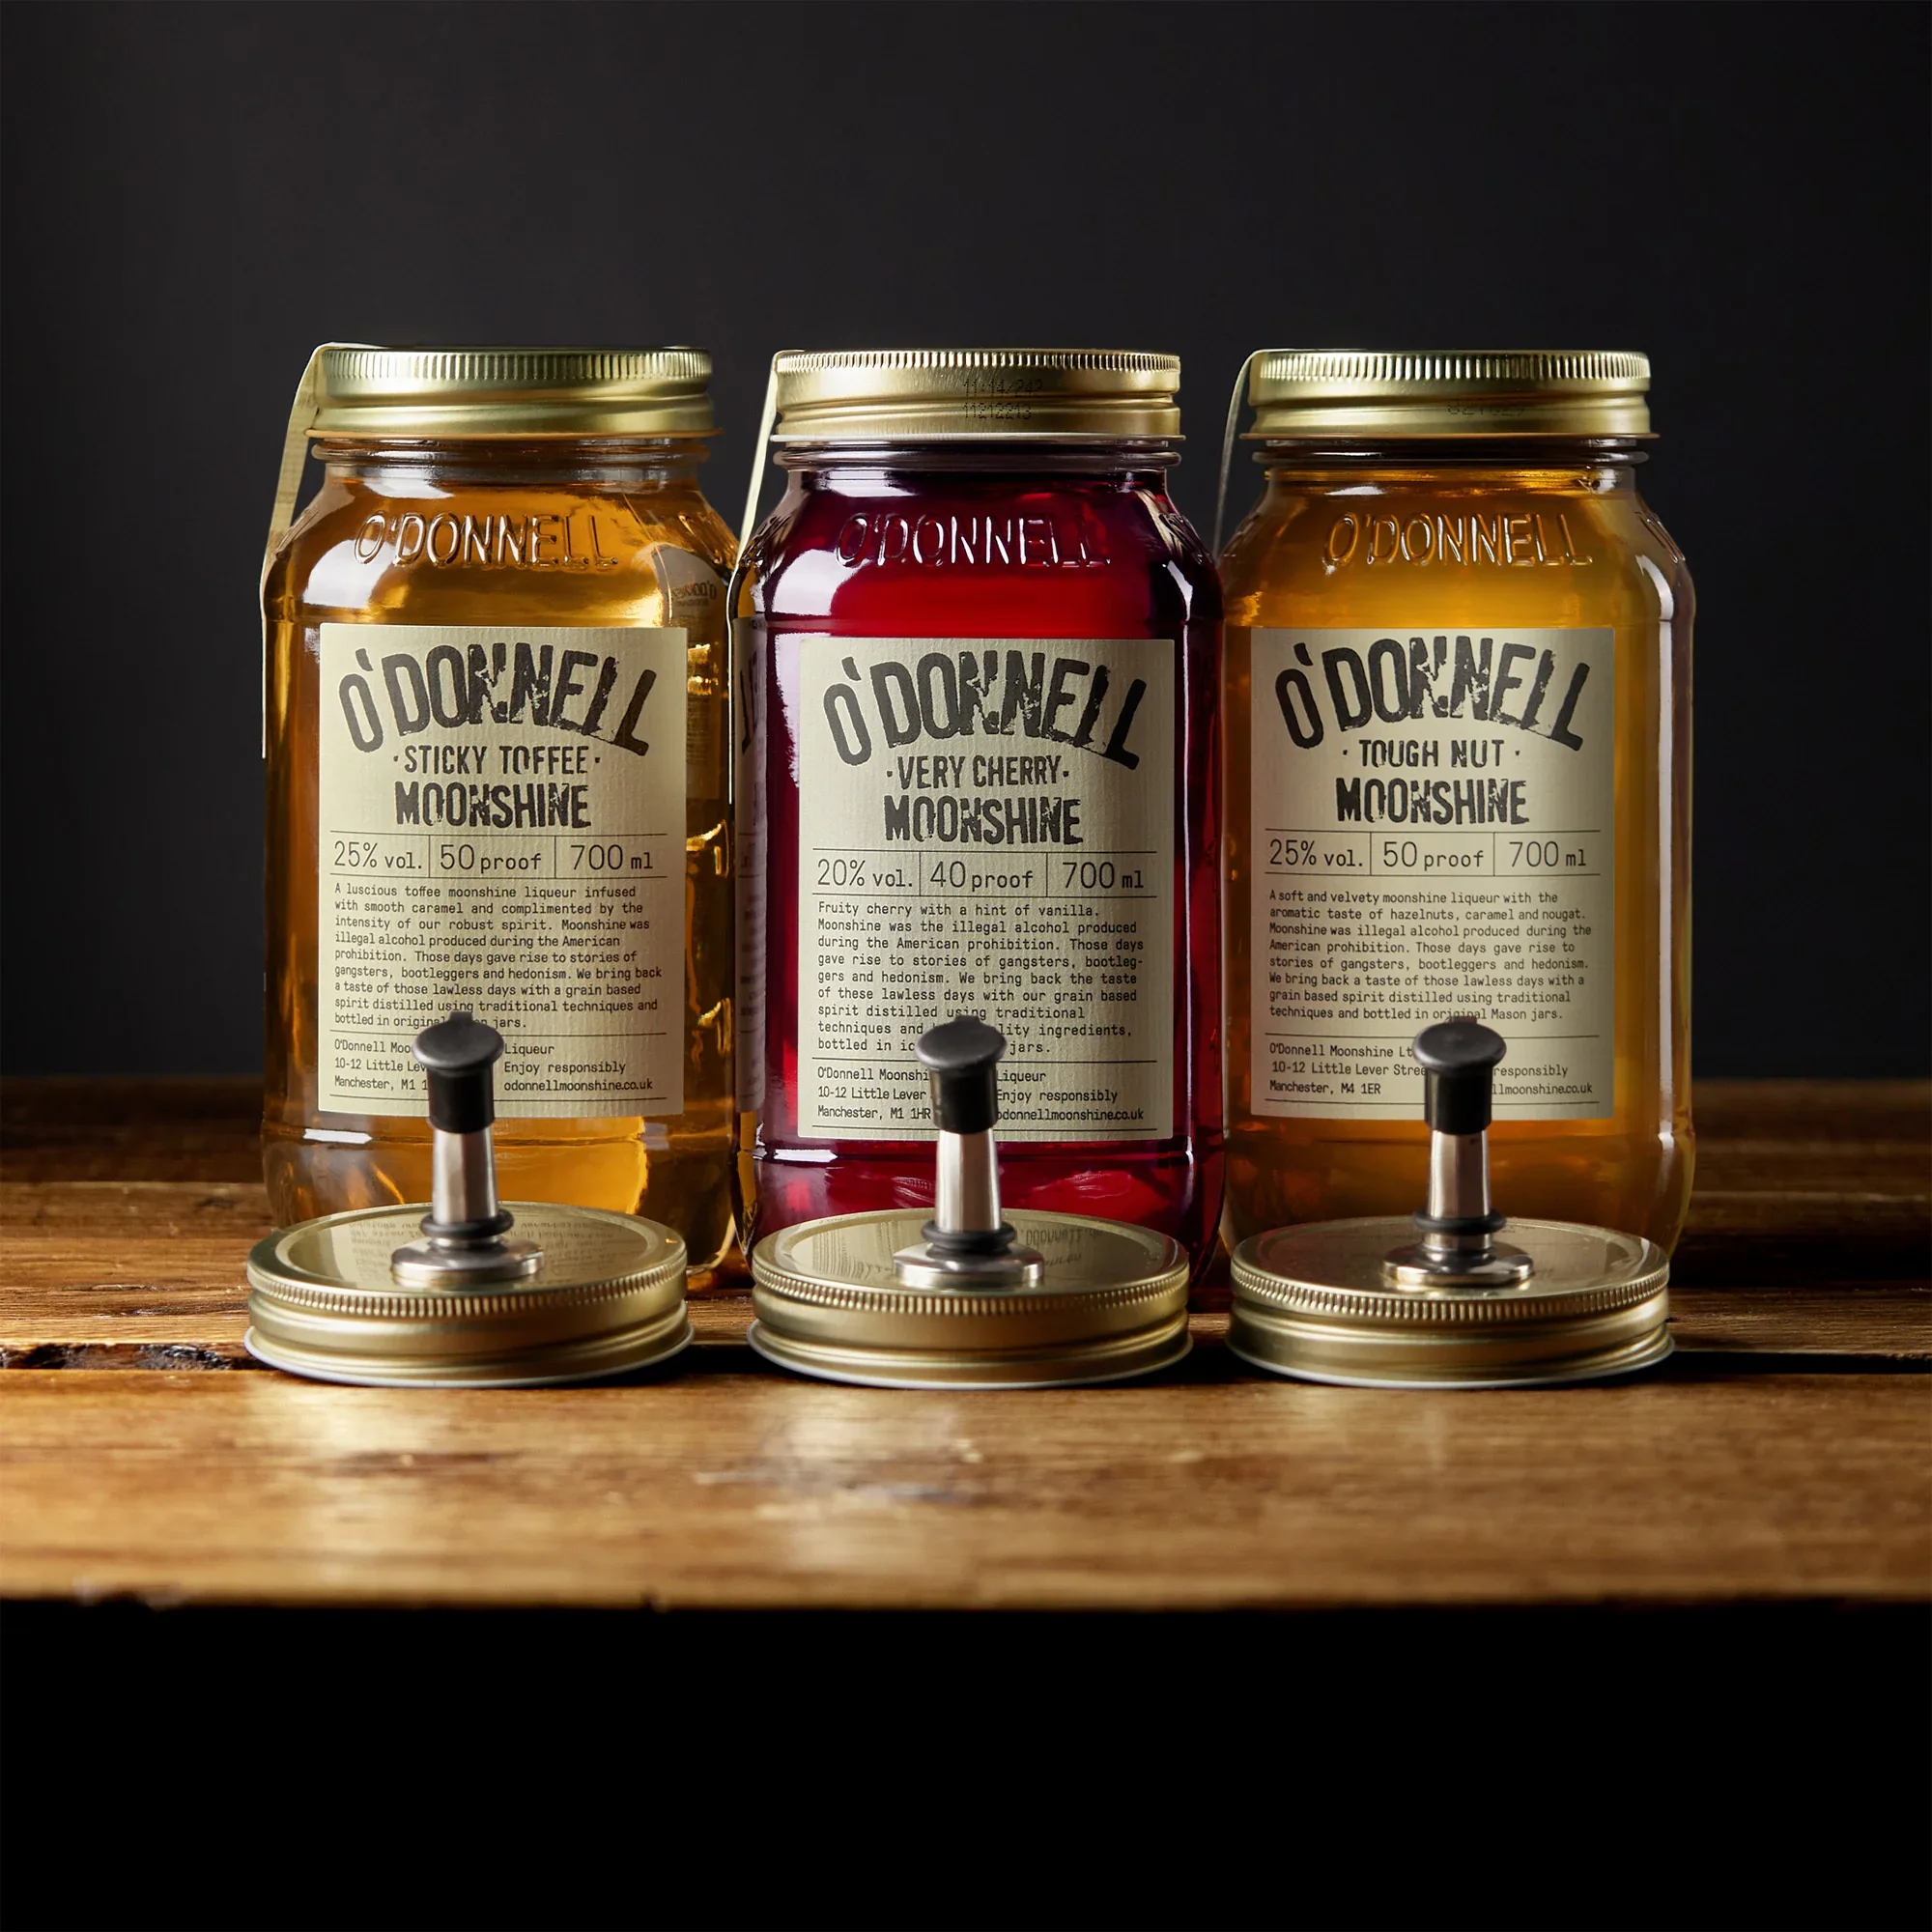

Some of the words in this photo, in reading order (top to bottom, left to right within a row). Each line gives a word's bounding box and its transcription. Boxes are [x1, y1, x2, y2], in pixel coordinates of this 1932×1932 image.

[355, 512, 618, 567] O'DONNELL
[837, 512, 1111, 567] O'DONNELL
[1324, 512, 1593, 567] O'DONNELL
[339, 642, 656, 756] O'DONNELL
[1275, 635, 1590, 752] O'DONNELL
[823, 650, 1147, 770] O'DONNELL
[405, 745, 487, 775] STICKY
[499, 745, 589, 775] TOFFEE
[1358, 739, 1438, 768] TOUGH
[1451, 739, 1505, 768] NUT
[897, 755, 965, 790] VERY
[973, 755, 1062, 787] CHERRY
[395, 781, 591, 828] MOONSHINE
[1336, 777, 1530, 825] MOONSHINE
[884, 795, 1084, 845] MOONSHINE
[333, 840, 378, 868] 25%
[384, 852, 421, 868] vol.
[440, 844, 474, 869] 50
[481, 853, 541, 874] proof
[570, 844, 624, 871] 700
[630, 852, 653, 869] ml
[1270, 838, 1317, 866] 25%
[1324, 849, 1362, 867] vol.
[1383, 841, 1417, 867] 50
[1425, 850, 1484, 871] proof
[1509, 841, 1558, 867] 700
[1566, 849, 1586, 866] ml
[818, 859, 866, 886] 20%
[872, 869, 912, 887] vol.
[930, 861, 966, 888] 40
[972, 870, 1034, 893] proof
[1063, 862, 1115, 889] 700
[1122, 870, 1145, 890] ml
[335, 883, 340, 893] A
[348, 883, 397, 895] luscious
[405, 886, 440, 896] toffee
[448, 887, 516, 897] moonshine
[525, 886, 577, 899] liqueur
[585, 886, 636, 897] infused
[1269, 890, 1276, 899] A
[1279, 890, 1303, 901] soft
[1307, 891, 1326, 901] and
[1330, 892, 1379, 905] velvety
[1383, 893, 1446, 903] moonshine
[1451, 893, 1499, 905] liqueur
[1503, 893, 1531, 903] with
[1539, 893, 1557, 902] the
[335, 900, 357, 910] with
[365, 902, 404, 912] smooth
[412, 902, 463, 914] caramel
[471, 903, 493, 914] and
[502, 902, 591, 916] complimented
[600, 903, 613, 916] by
[622, 902, 643, 913] the
[819, 901, 859, 916] Fruity
[867, 903, 912, 917] cherry
[921, 903, 951, 915] with
[960, 907, 966, 916] a
[976, 904, 1007, 916] hint
[1015, 904, 1030, 916] of
[1038, 904, 1098, 916] vanilla.
[1270, 907, 1320, 919] aromatic
[1327, 908, 1361, 920] taste
[1370, 908, 1382, 920] of
[1391, 909, 1459, 921] hazelnuts,
[1465, 909, 1514, 920] caramel
[1519, 909, 1538, 920] and
[1543, 908, 1584, 922] nougat.
[336, 917, 390, 930] intensity
[398, 918, 411, 928] of
[449, 919, 494, 930] robust
[502, 919, 552, 932] spirit.
[562, 919, 626, 930] Moonshine
[630, 921, 649, 929] was
[818, 919, 881, 931] Moonshine
[889, 923, 911, 931] was
[921, 920, 943, 932] the
[952, 921, 1007, 935] illegal
[1015, 922, 1069, 933] alcohol
[1078, 922, 1136, 935] produced
[336, 931, 375, 946] illegal
[379, 934, 425, 945] alcohol
[430, 935, 486, 948] produced
[490, 935, 533, 949] during
[537, 936, 558, 946] the
[562, 935, 620, 947] American
[1269, 939, 1320, 952] American
[1327, 942, 1408, 954] prohibition.
[1416, 942, 1451, 952] Those
[1459, 942, 1486, 955] days
[1494, 945, 1521, 955] gave
[1562, 942, 1575, 952] to
[818, 955, 844, 966] gave
[853, 953, 881, 965] rise
[890, 954, 903, 965] to
[913, 954, 966, 966] stories
[976, 955, 990, 966] of
[999, 955, 1075, 969] gangsters,
[1086, 955, 1143, 970] bootleg-
[1270, 956, 1313, 968] stories
[1321, 957, 1333, 968] of
[1341, 959, 1408, 972] gangsters,
[1419, 958, 1495, 972] bootleggers
[1504, 959, 1523, 969] and
[1532, 958, 1587, 969] hedonism.
[335, 966, 392, 979] gangsters,
[402, 967, 479, 980] bootleggers
[483, 968, 504, 979] and
[508, 968, 571, 979] hedonism.
[577, 968, 591, 979] We
[596, 968, 631, 981] bring
[636, 966, 662, 978] back
[818, 986, 830, 997] of
[838, 987, 872, 999] these
[882, 988, 935, 1000] lawless
[944, 989, 975, 1003] days
[983, 989, 1014, 1001] with
[1023, 992, 1046, 1001] our
[1054, 990, 1093, 1004] grain
[1101, 989, 1136, 1002] based
[335, 1038, 385, 1052] O'Donnell
[505, 1043, 554, 1057] Liqueur
[1270, 1042, 1324, 1056] O'Donnell
[1330, 1045, 1393, 1057] Moonshine
[336, 1058, 361, 1069] 10-12
[367, 1060, 403, 1071] Little
[504, 1062, 540, 1075] Enjoy
[549, 1061, 626, 1075] responsibly
[818, 1066, 873, 1080] O'Donnell
[1272, 1061, 1305, 1072] 10-12
[1312, 1063, 1351, 1074] Little
[1356, 1064, 1389, 1075] Lever
[335, 1075, 394, 1090] Manchester,
[402, 1079, 415, 1090] M1
[504, 1078, 653, 1091] odonnellmoonshine.co.uk
[1270, 1080, 1333, 1094] Manchester,
[1341, 1083, 1354, 1094] M4
[1361, 1083, 1380, 1094] 1ER
[818, 1086, 846, 1098] 10-12
[852, 1088, 890, 1099] Little
[894, 1088, 926, 1099] Lever
[1039, 1090, 1118, 1104] responsibly
[818, 1105, 882, 1120] Manchester,
[891, 1107, 904, 1119] M1
[911, 1108, 930, 1119] 1HR
